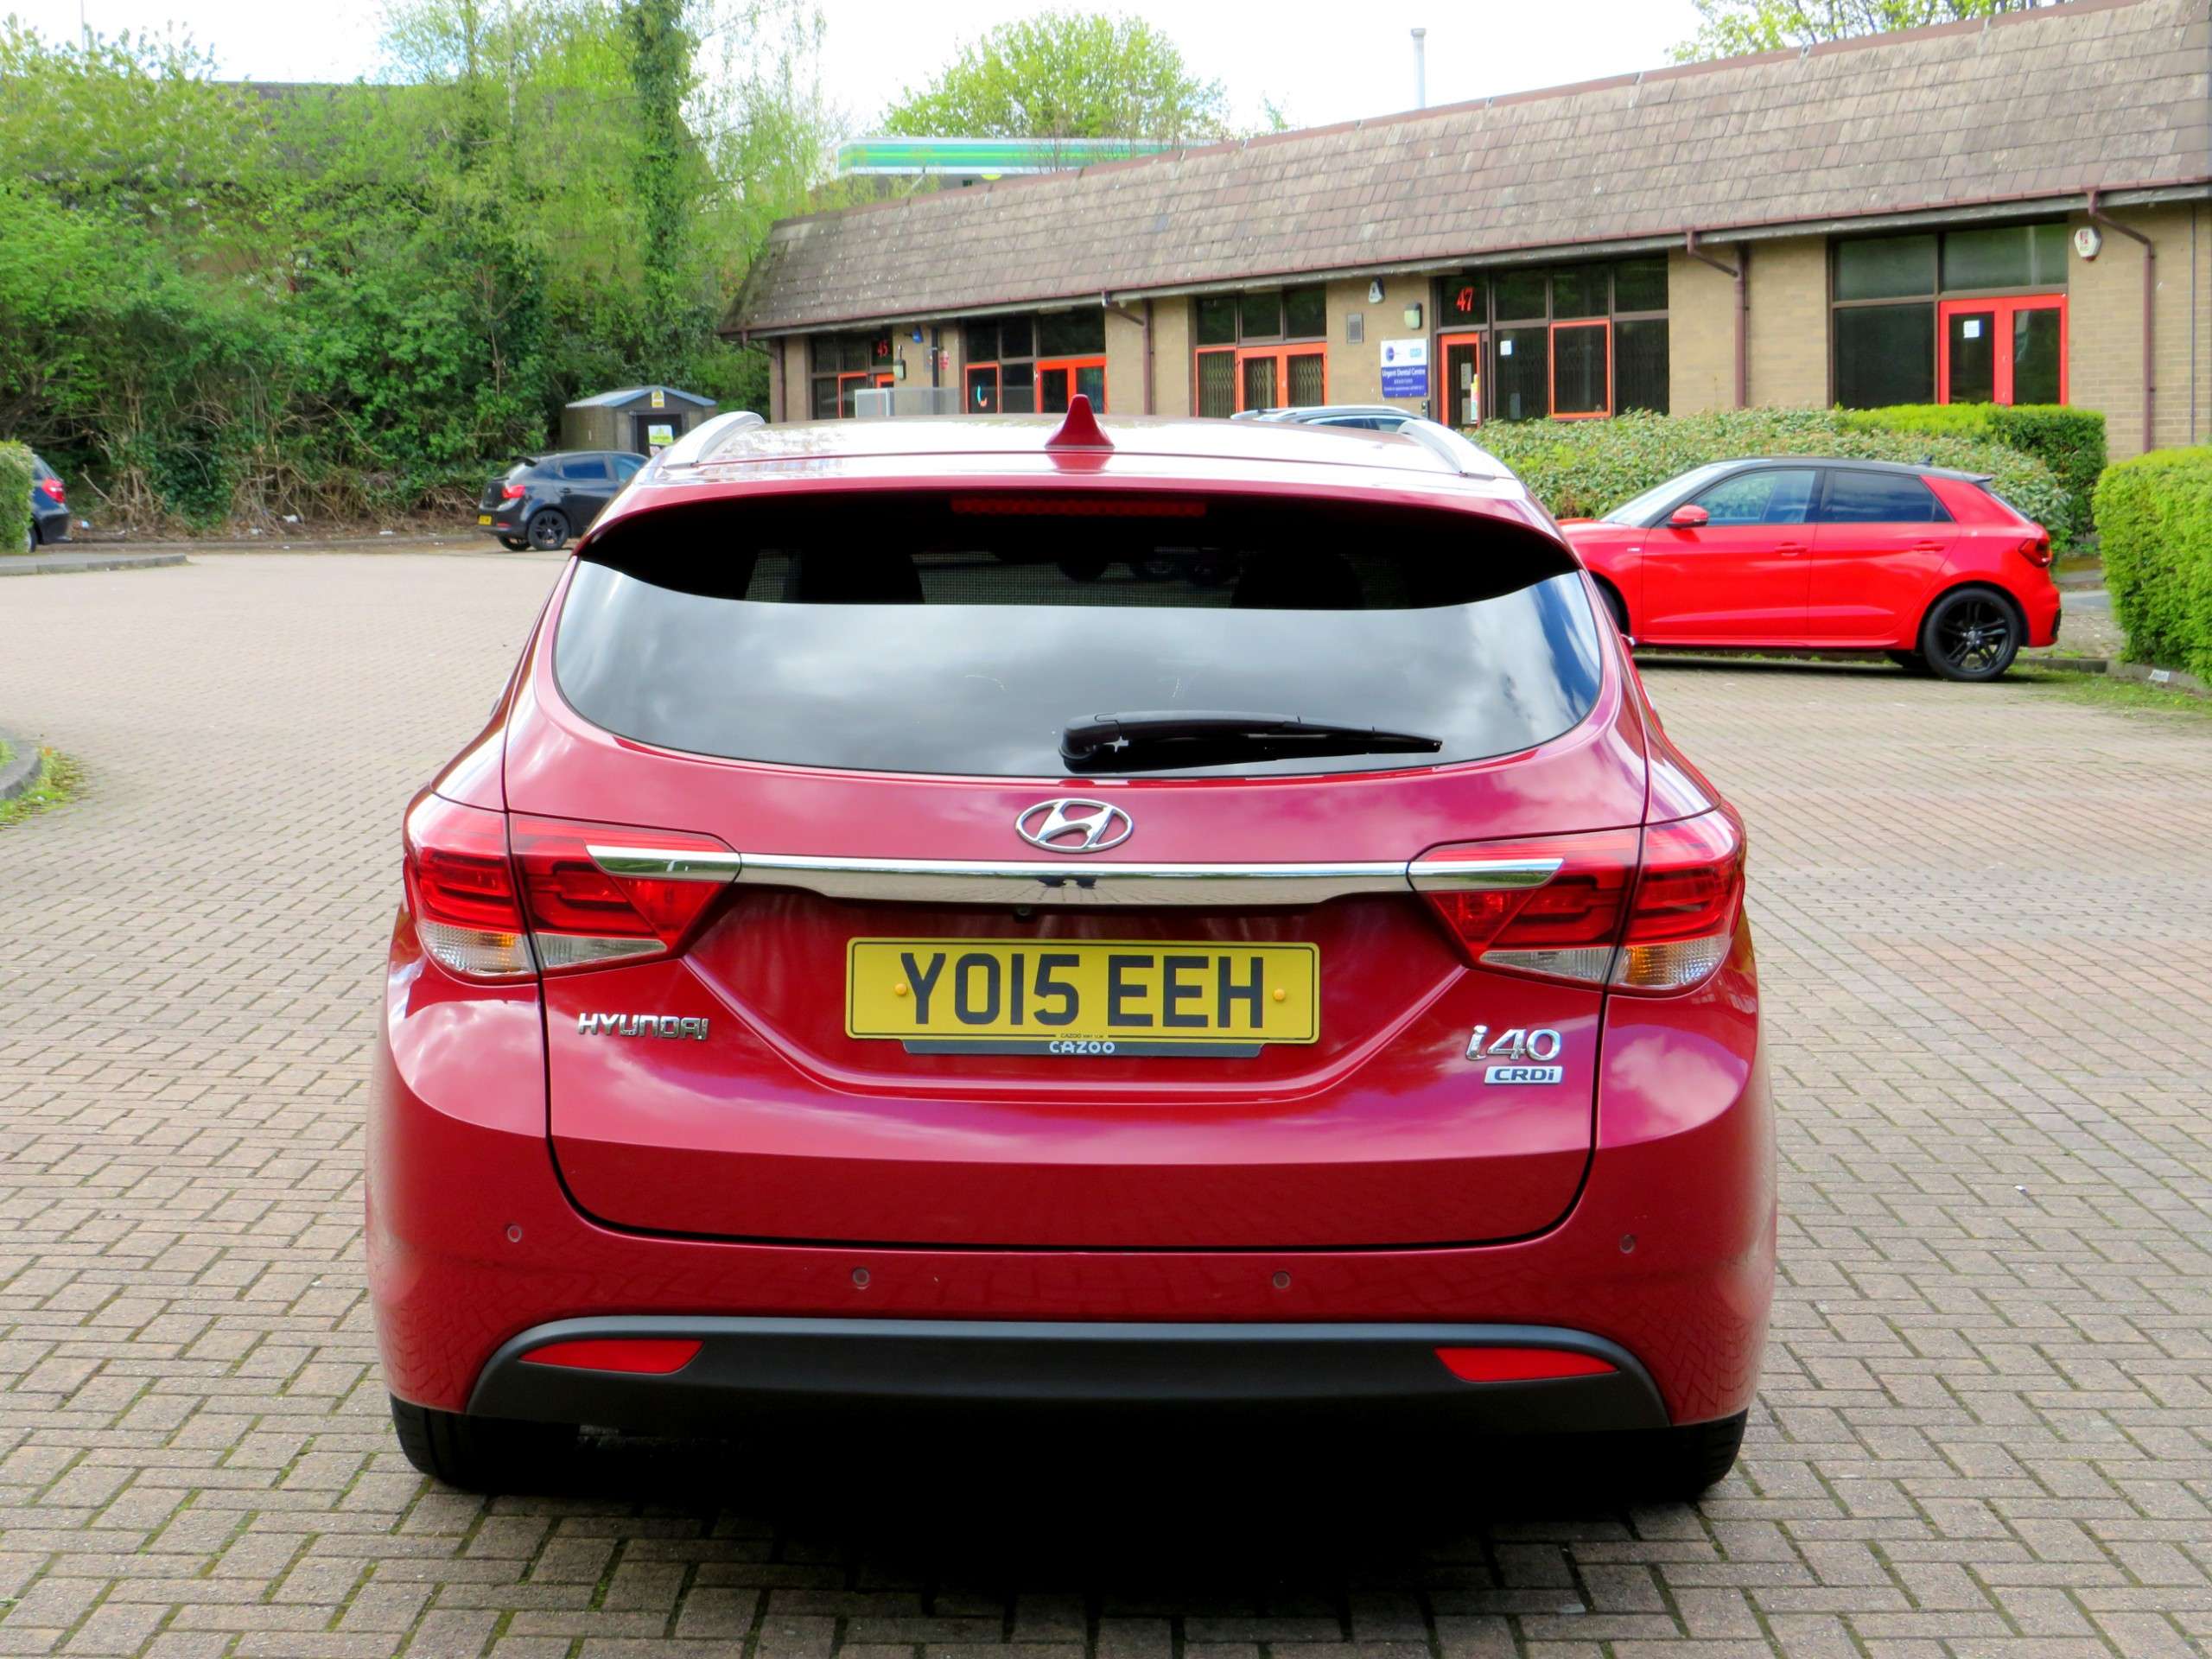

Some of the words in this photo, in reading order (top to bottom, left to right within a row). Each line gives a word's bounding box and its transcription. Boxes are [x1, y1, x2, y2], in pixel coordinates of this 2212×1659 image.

[1456, 286, 1475, 312] 47
[1396, 368, 1411, 377] Dental
[900, 951, 1081, 1027] YO15
[1107, 953, 1264, 1028] EEH
[577, 1013, 709, 1040] HYUNDAI
[1049, 1040, 1116, 1054] CAZOO
[1465, 1024, 1562, 1061] i40
[1494, 1068, 1555, 1081] CRDi
